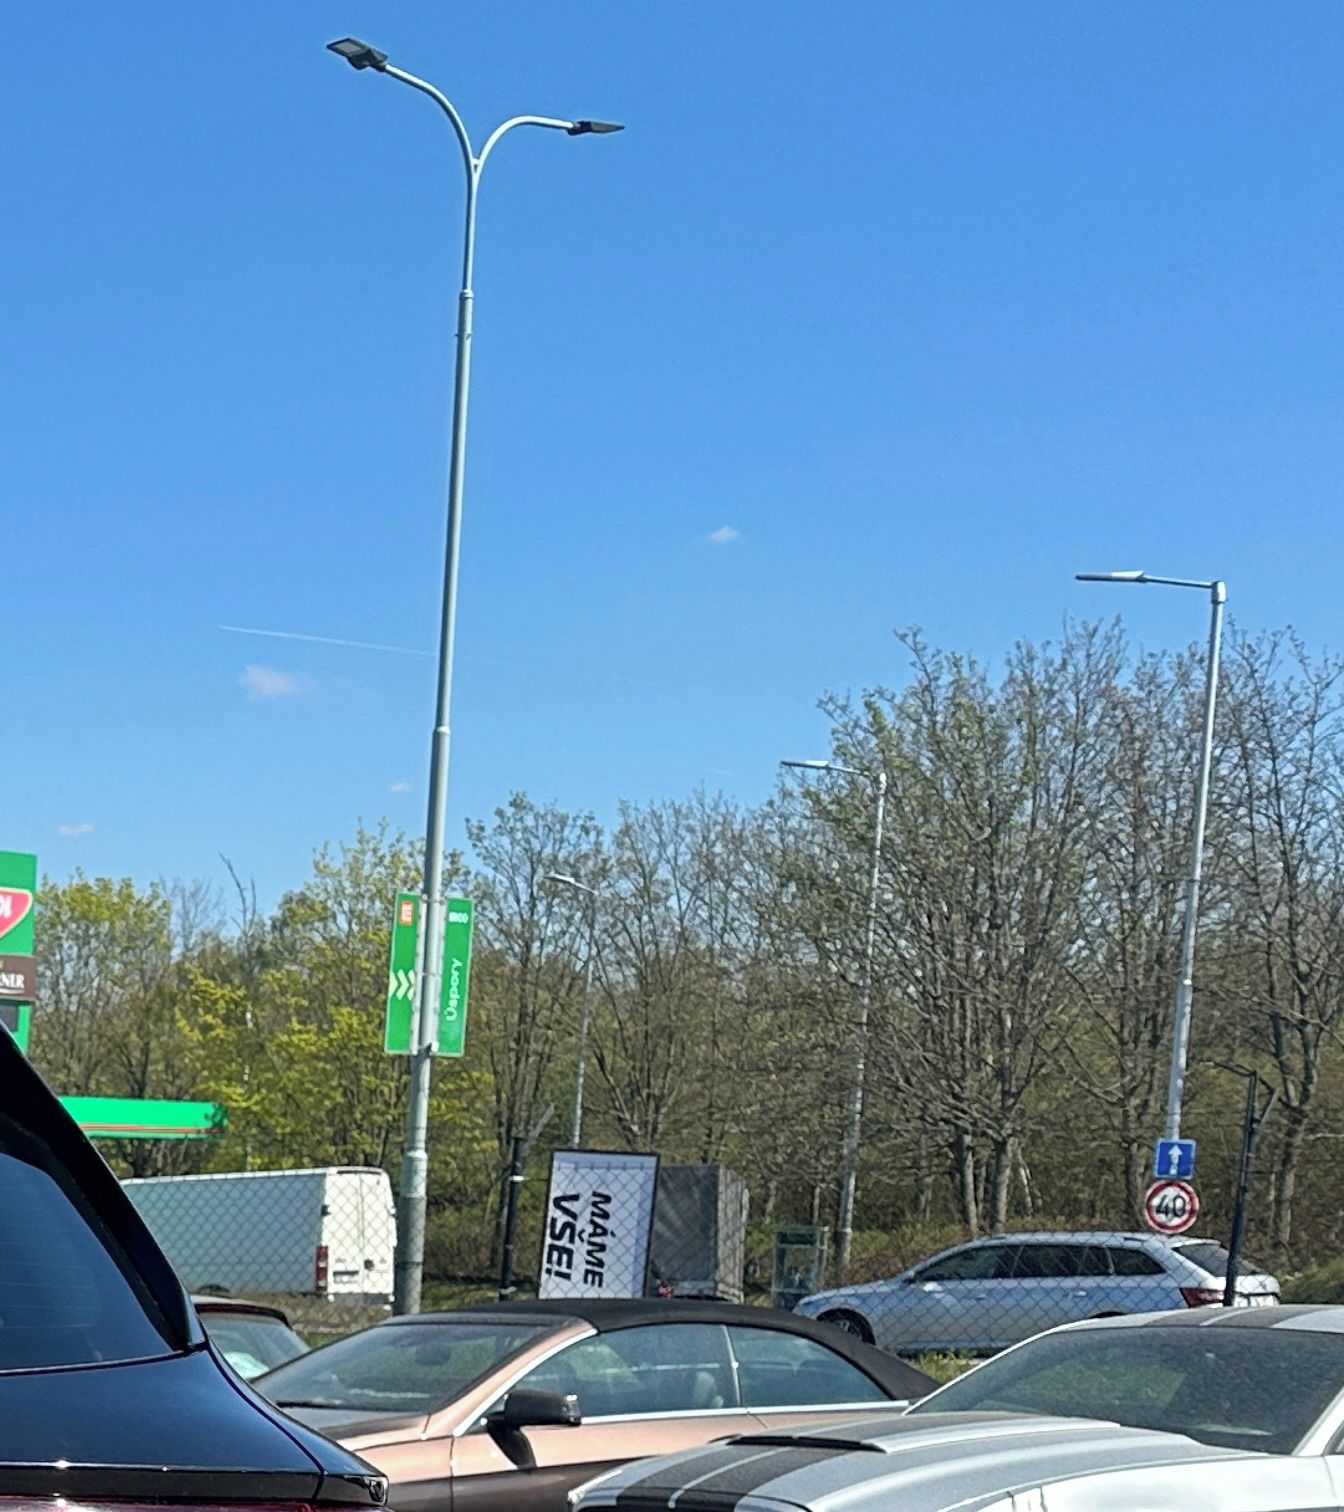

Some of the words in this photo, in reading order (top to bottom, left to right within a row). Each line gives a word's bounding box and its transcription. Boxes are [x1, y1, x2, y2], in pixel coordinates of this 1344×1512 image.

[444, 958, 462, 1021] Úspory
[545, 1193, 586, 1281] VŠE!
[583, 1191, 616, 1288] MÁME
[1155, 1194, 1186, 1217] 40
